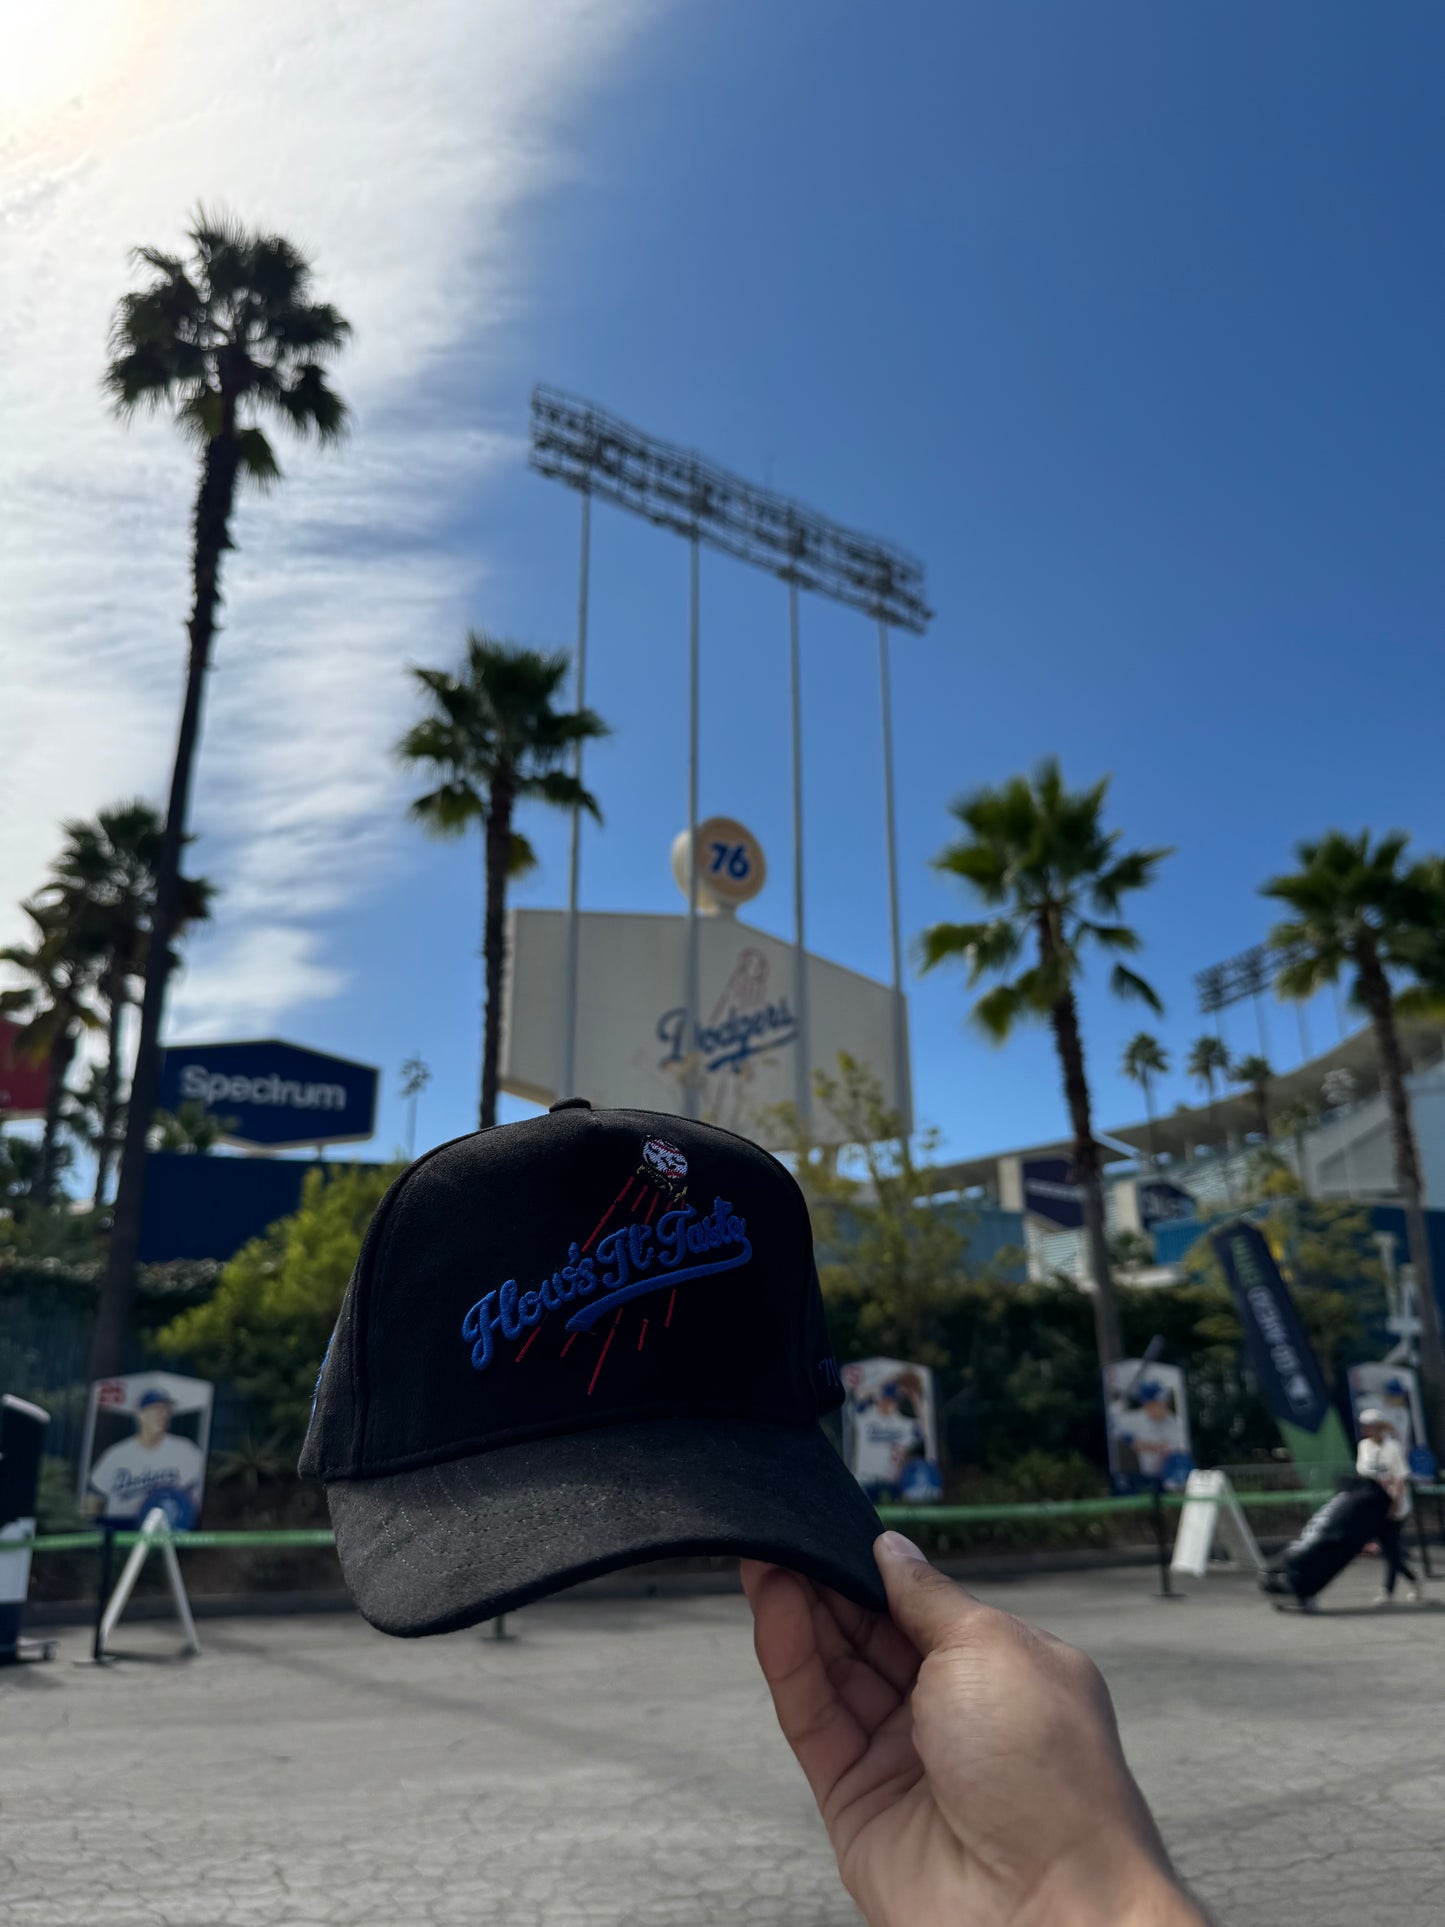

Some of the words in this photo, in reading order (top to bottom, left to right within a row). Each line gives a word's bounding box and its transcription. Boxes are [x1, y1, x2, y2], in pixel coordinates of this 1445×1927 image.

[710, 842, 751, 881] 76
[656, 997, 799, 1070] Dodgers
[181, 1064, 346, 1111] Spectrum
[597, 1224, 654, 1289] It
